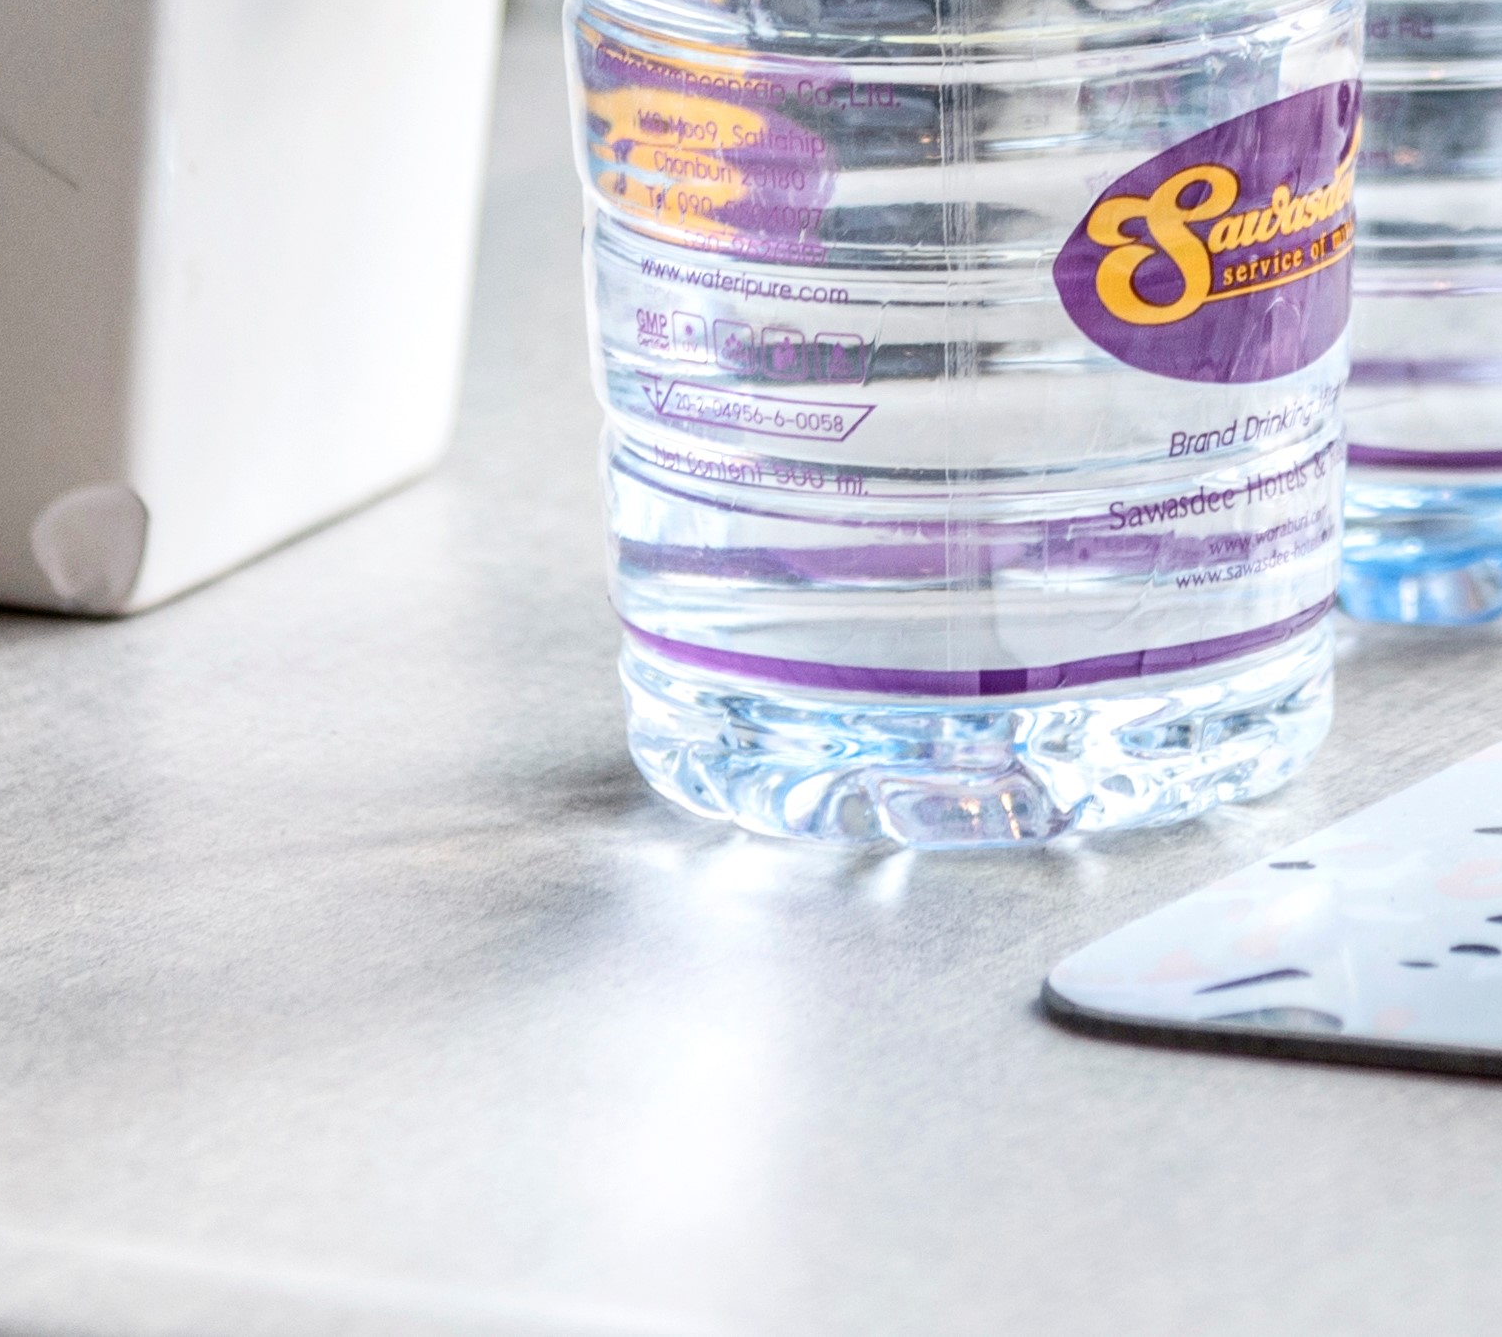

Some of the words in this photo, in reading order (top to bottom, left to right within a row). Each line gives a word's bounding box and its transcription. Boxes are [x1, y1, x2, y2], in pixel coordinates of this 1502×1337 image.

[798, 79, 902, 111] Co.,Ltd.
[653, 150, 733, 184] Chonburi
[640, 256, 849, 305] www.wateripure.com
[1222, 248, 1303, 286] service
[1310, 235, 1327, 260] of
[636, 308, 667, 337] GMP
[674, 392, 844, 433] 20-2-04956-6-0058
[1168, 419, 1237, 458] Brand
[1243, 400, 1314, 442] Drinking
[654, 444, 680, 471] Net
[687, 451, 763, 484] Content
[1108, 486, 1235, 531] Sawasdee
[1246, 459, 1308, 505] Hotels
[1314, 450, 1327, 478] &
